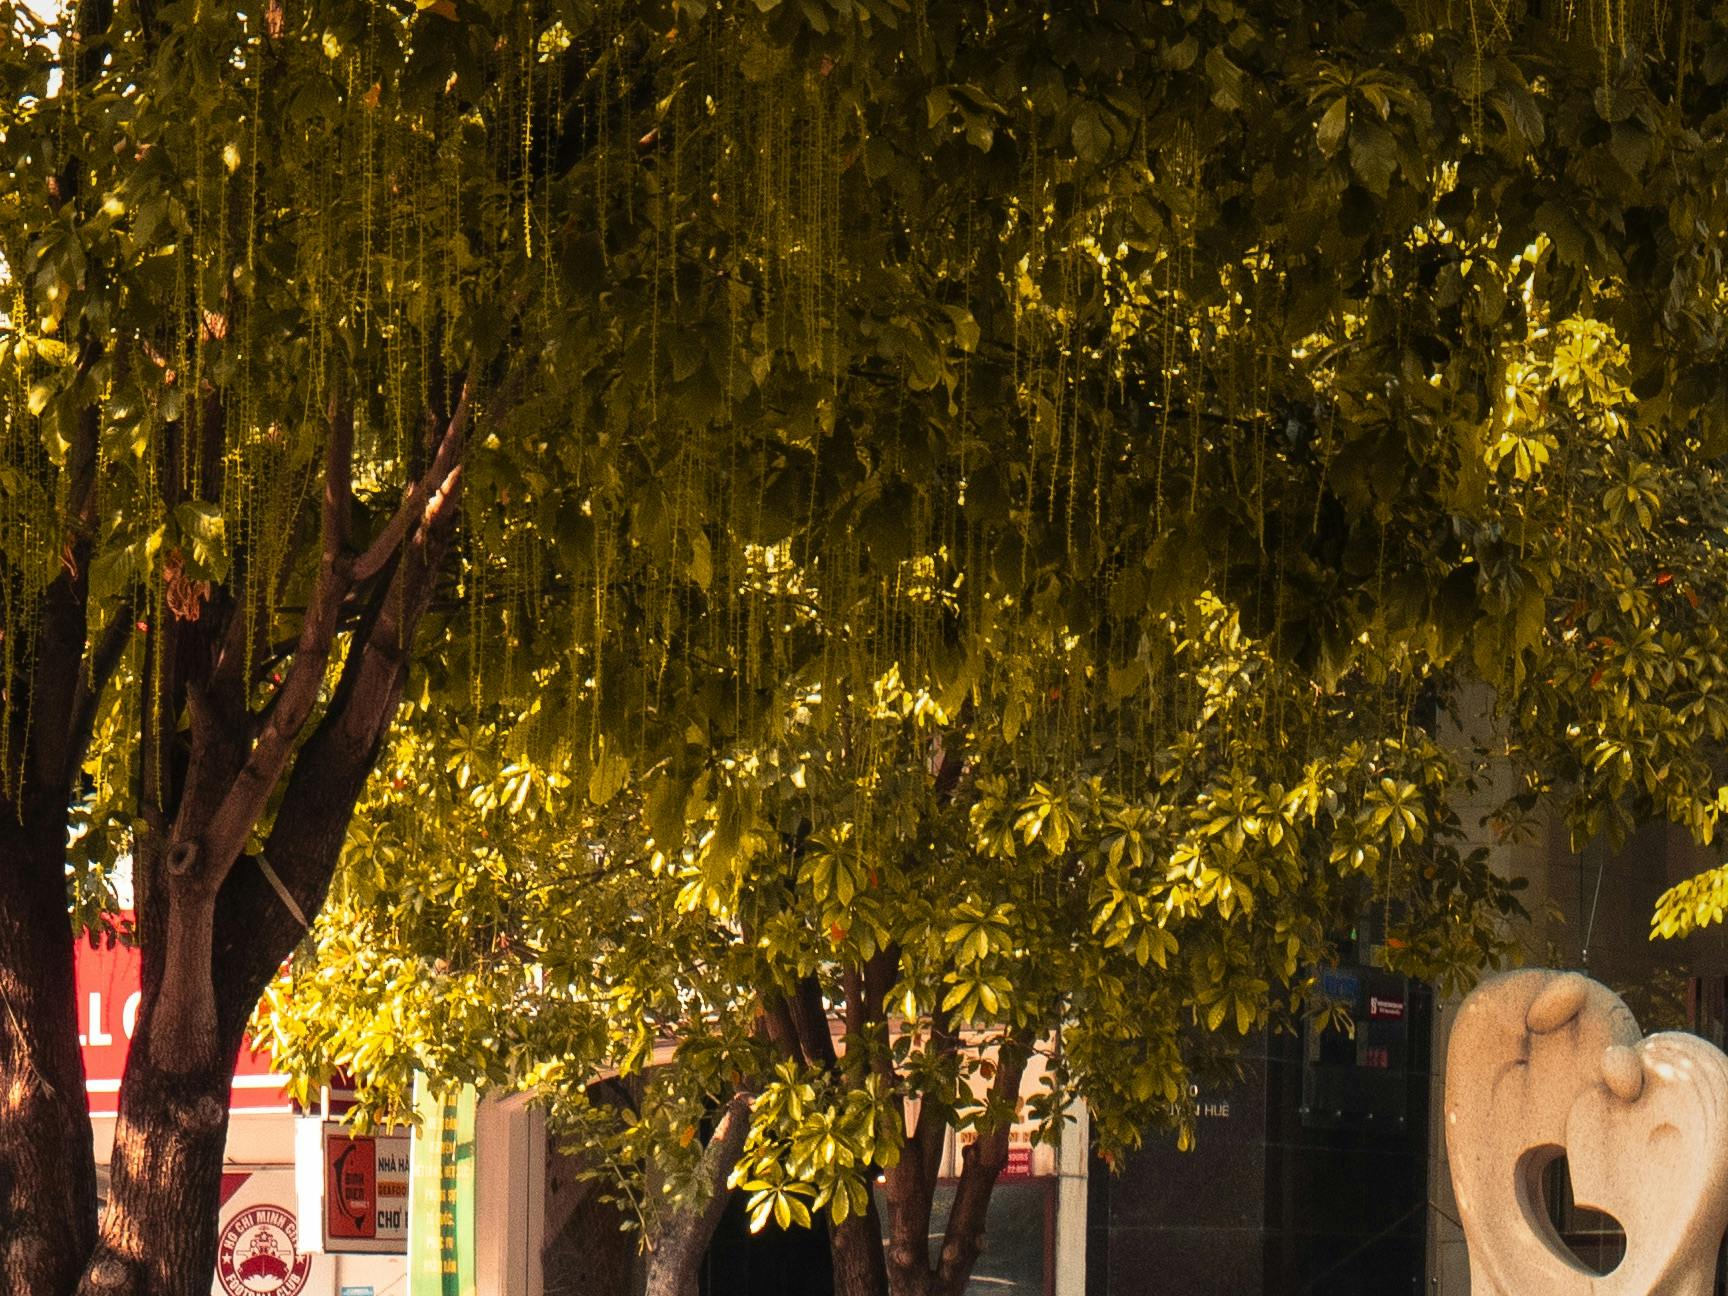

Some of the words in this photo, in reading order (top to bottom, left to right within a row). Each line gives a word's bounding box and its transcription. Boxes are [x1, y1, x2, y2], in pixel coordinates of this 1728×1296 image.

[378, 1152, 397, 1173] NHÀ
[378, 1183, 408, 1197] SEAFOO
[223, 1230, 239, 1251] HO
[234, 1213, 255, 1232] CHI
[255, 1210, 287, 1225] MINH
